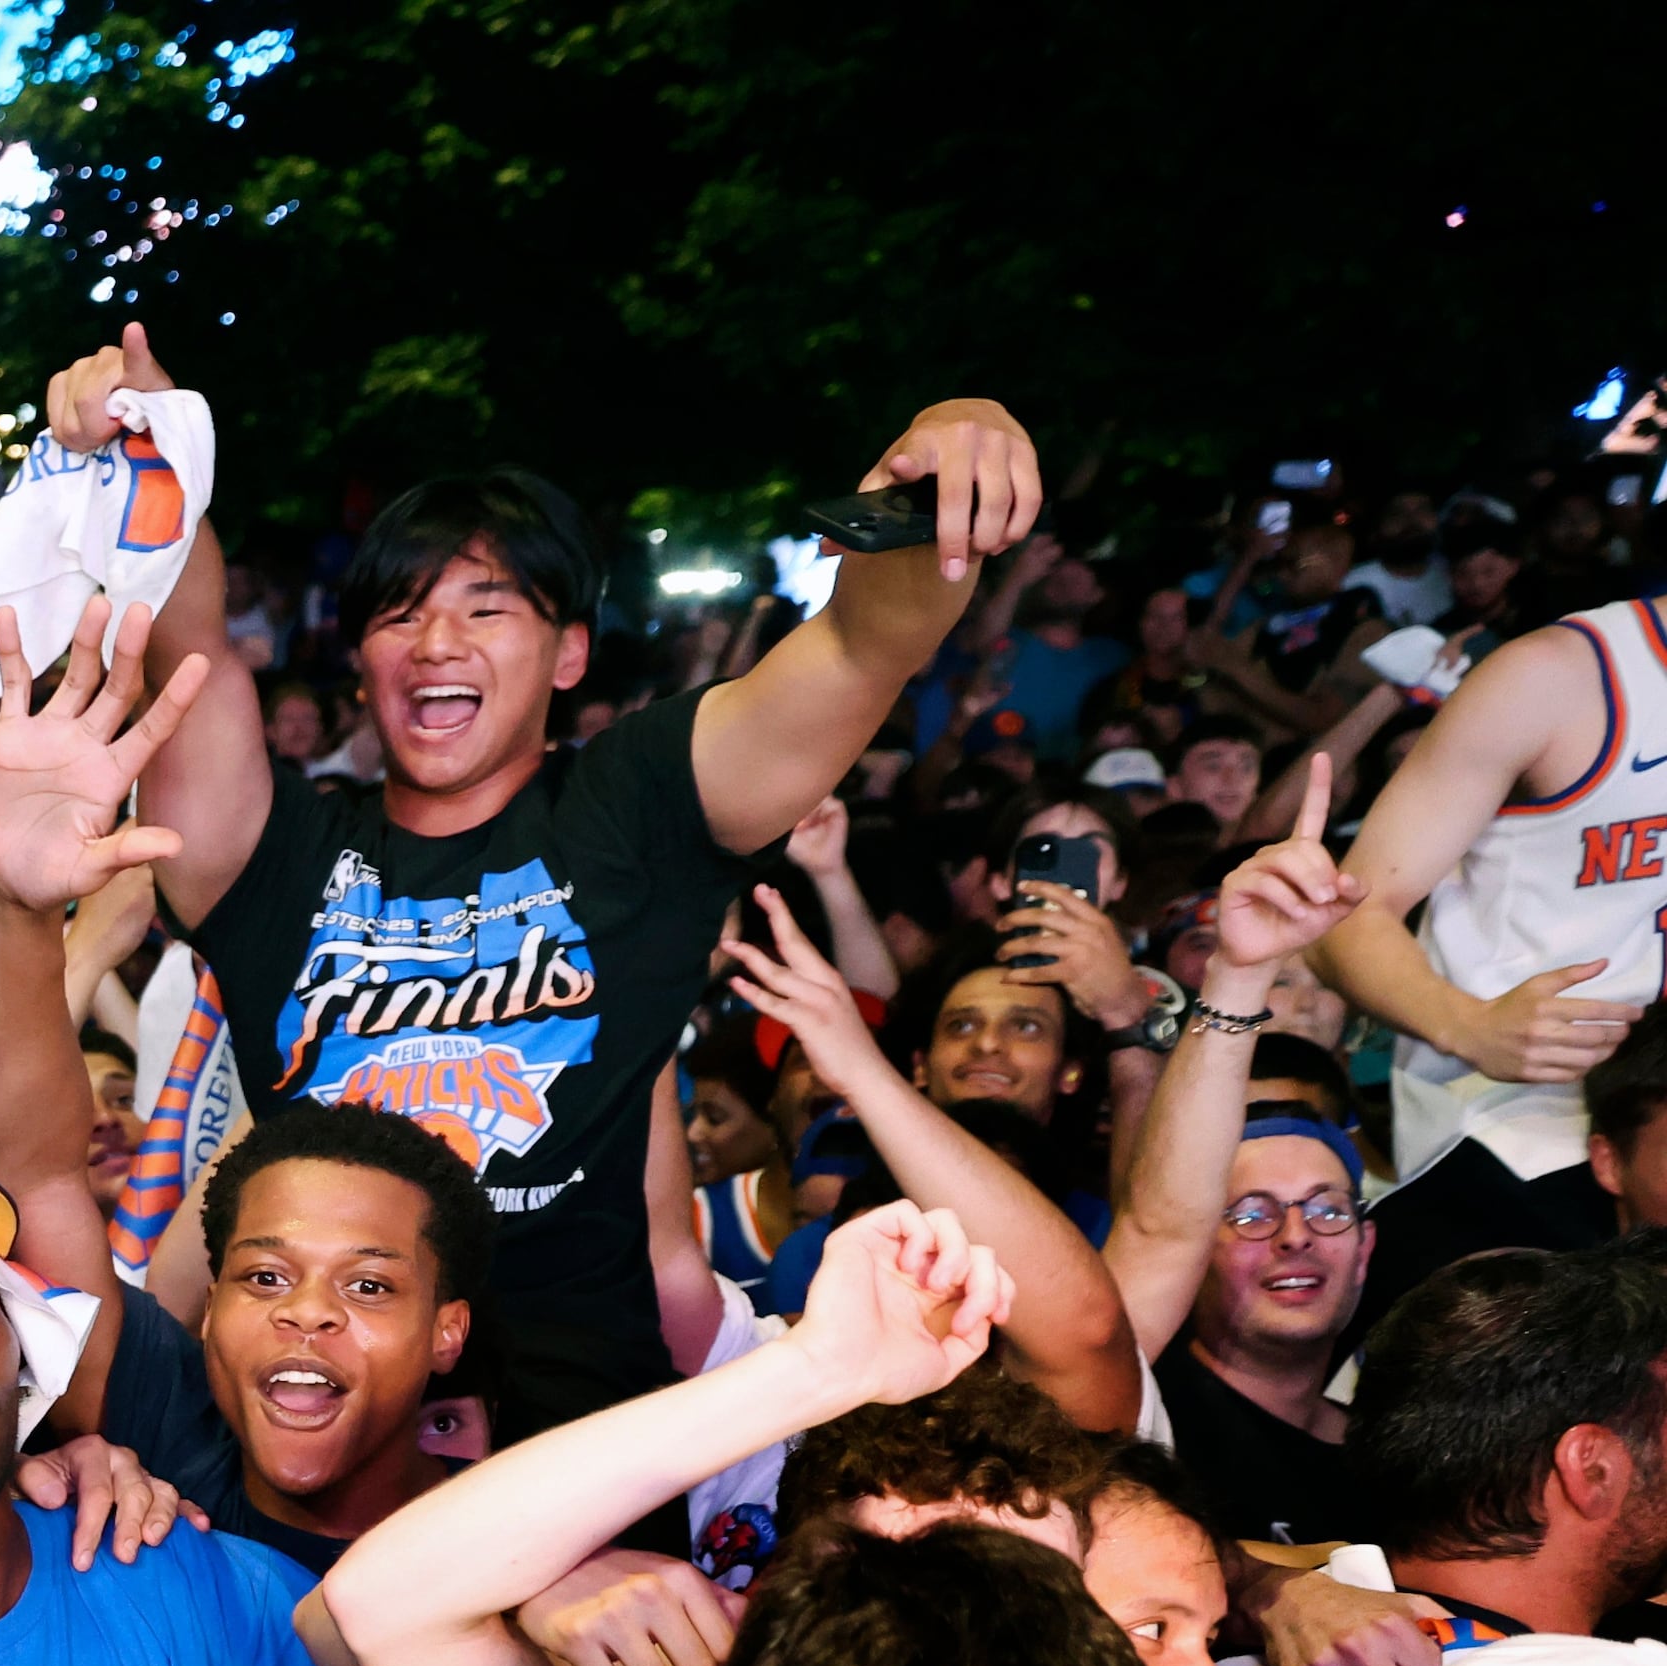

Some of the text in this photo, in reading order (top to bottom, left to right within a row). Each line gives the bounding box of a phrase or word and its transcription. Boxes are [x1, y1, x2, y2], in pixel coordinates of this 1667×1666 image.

[272, 924, 596, 1092] Finals
[334, 1047, 545, 1128] KNICKS
[387, 1039, 477, 1065] NEW YORK
